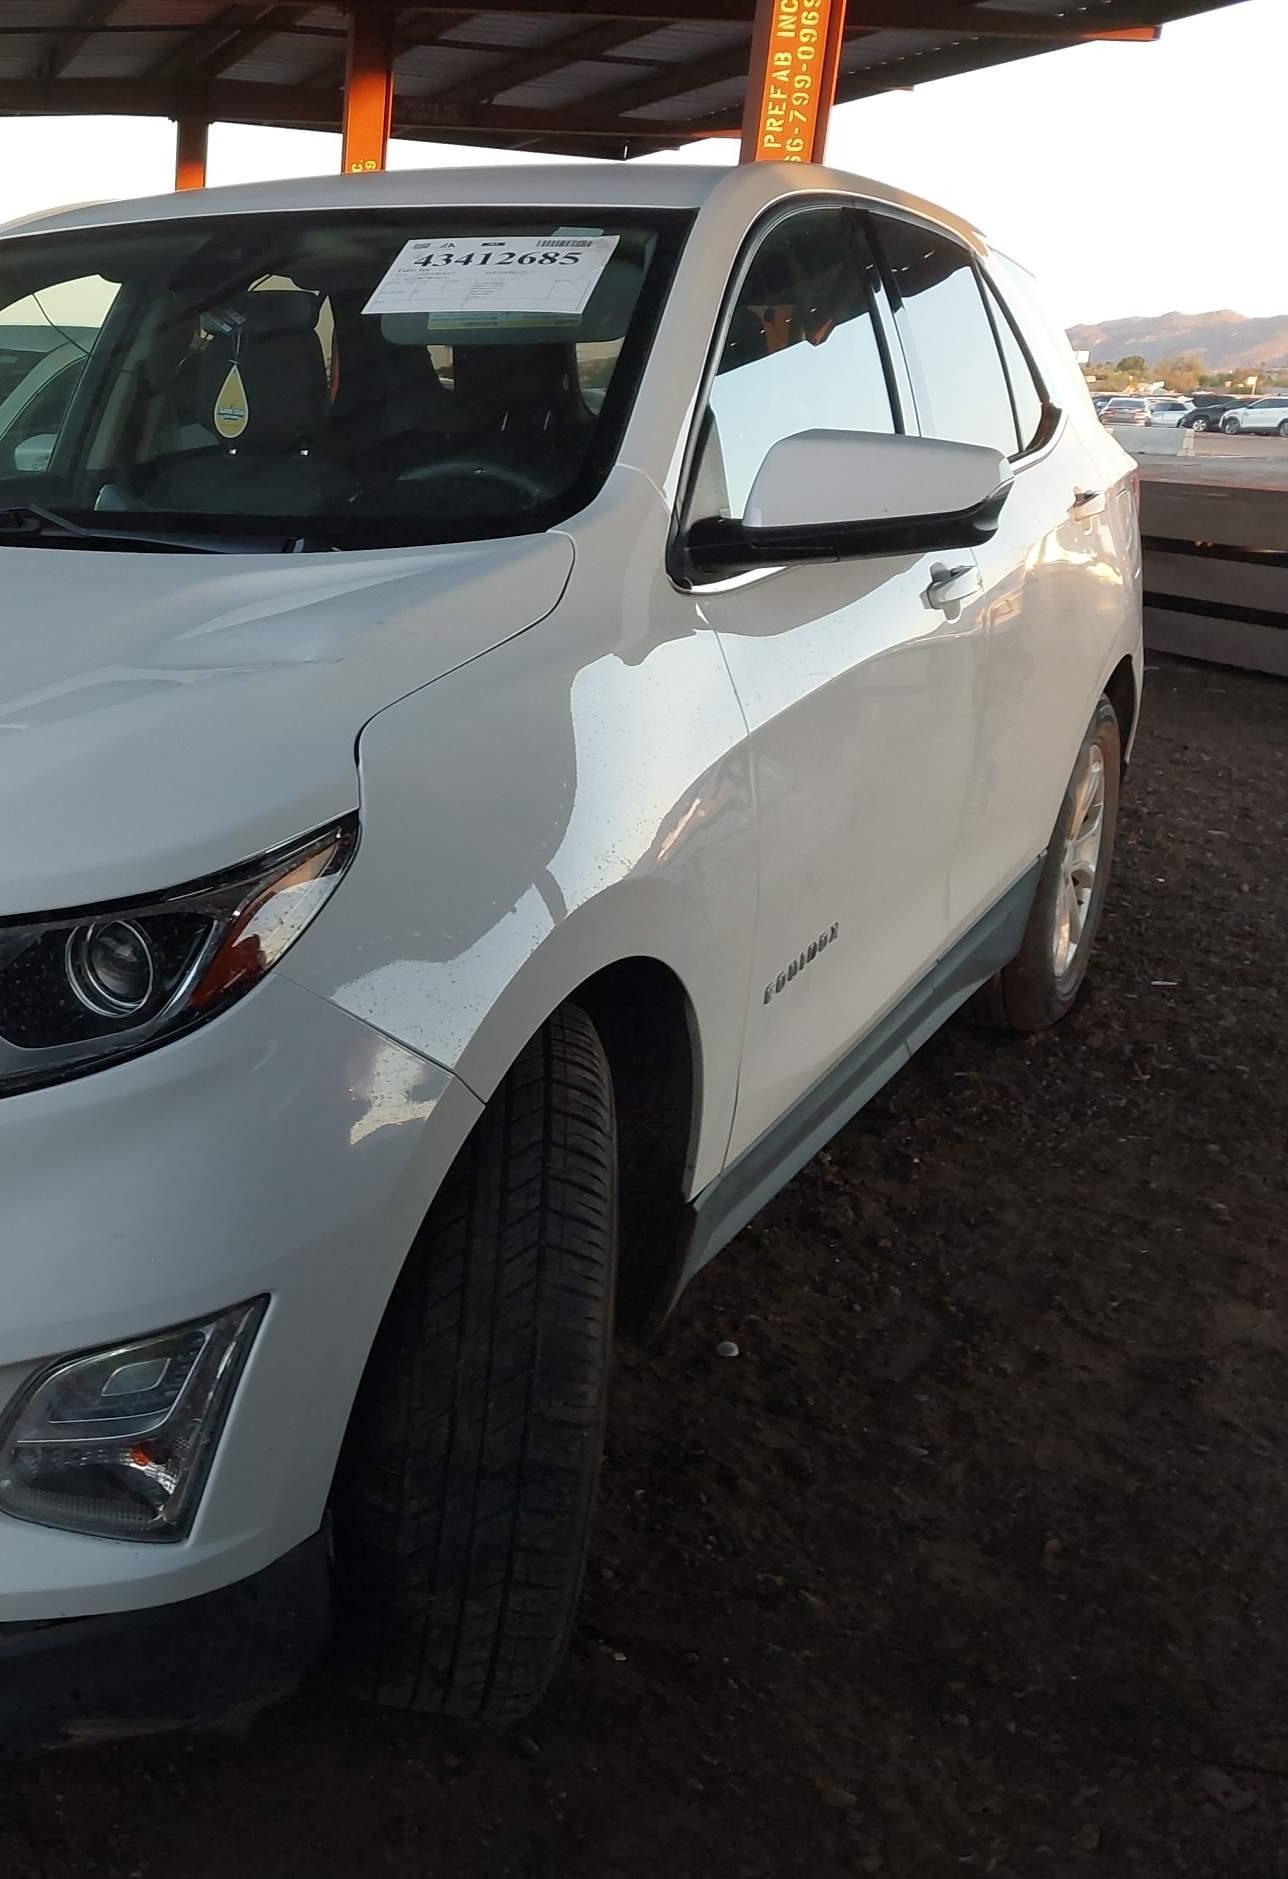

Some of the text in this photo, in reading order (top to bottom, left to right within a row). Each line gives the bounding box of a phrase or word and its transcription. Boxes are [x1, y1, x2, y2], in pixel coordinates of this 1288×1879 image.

[763, 0, 799, 148] PREFAB INC
[413, 251, 584, 267] 43412685
